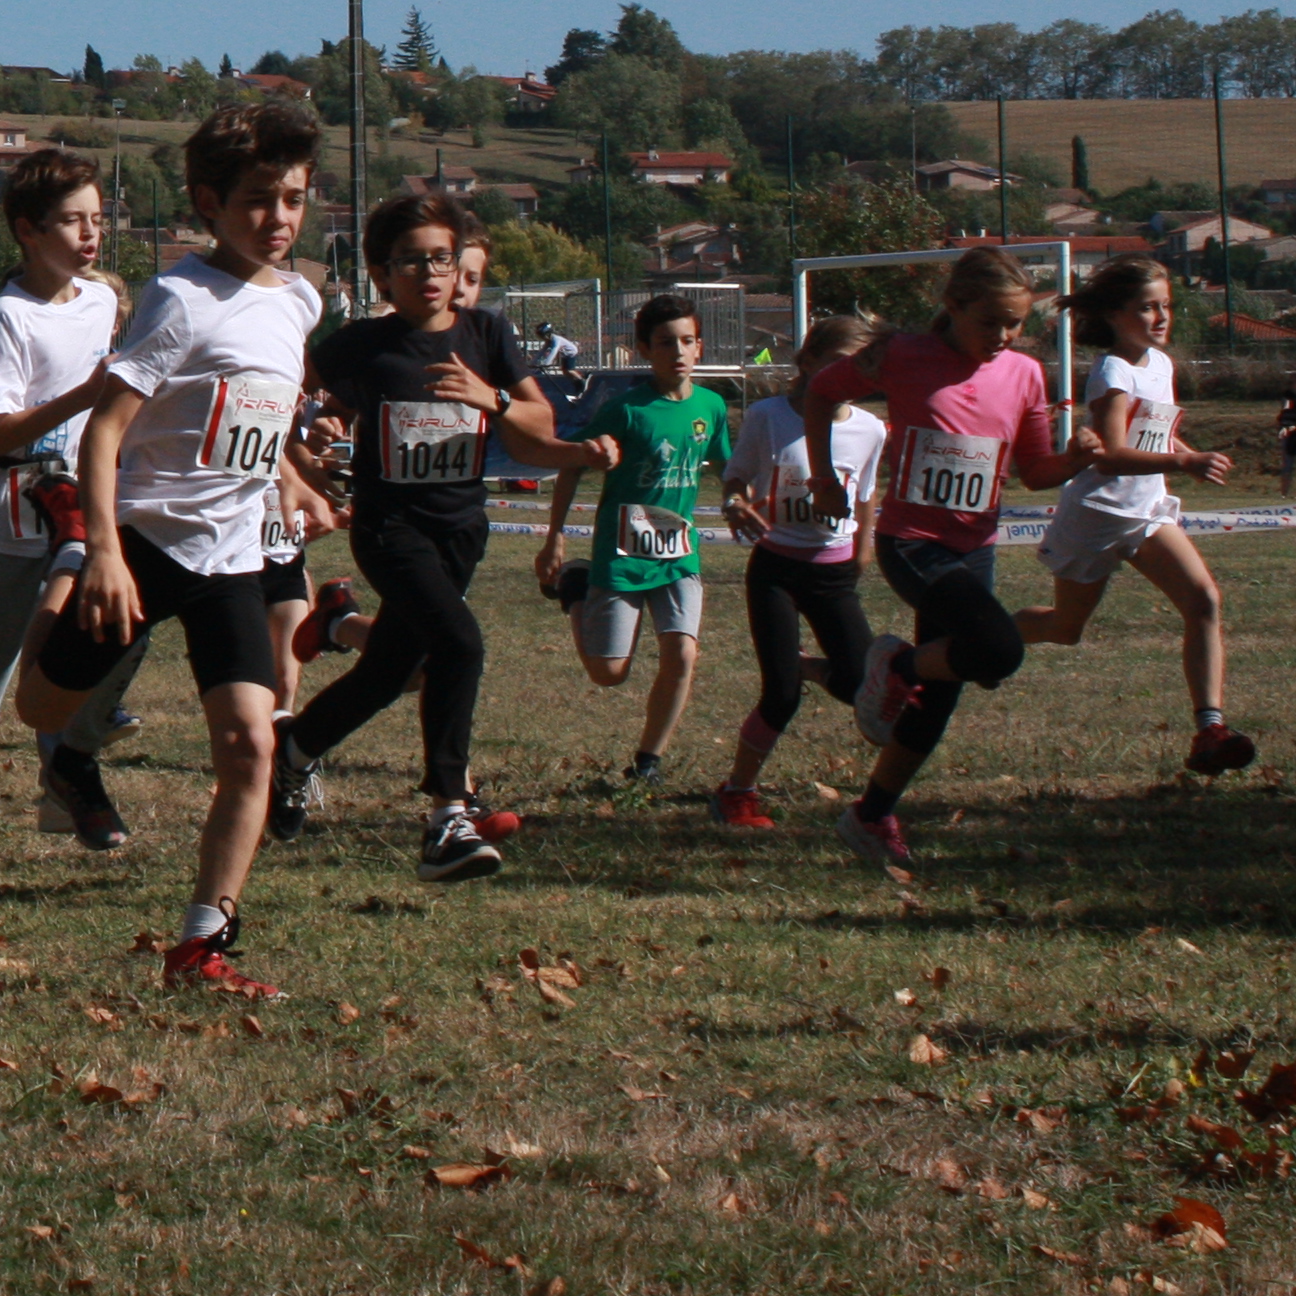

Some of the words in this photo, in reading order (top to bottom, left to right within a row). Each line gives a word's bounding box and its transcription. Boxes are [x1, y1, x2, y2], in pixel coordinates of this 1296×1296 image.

[225, 424, 287, 475] 104
[397, 441, 468, 479] 1044
[922, 467, 983, 508] 1010
[631, 528, 677, 554] 1000
